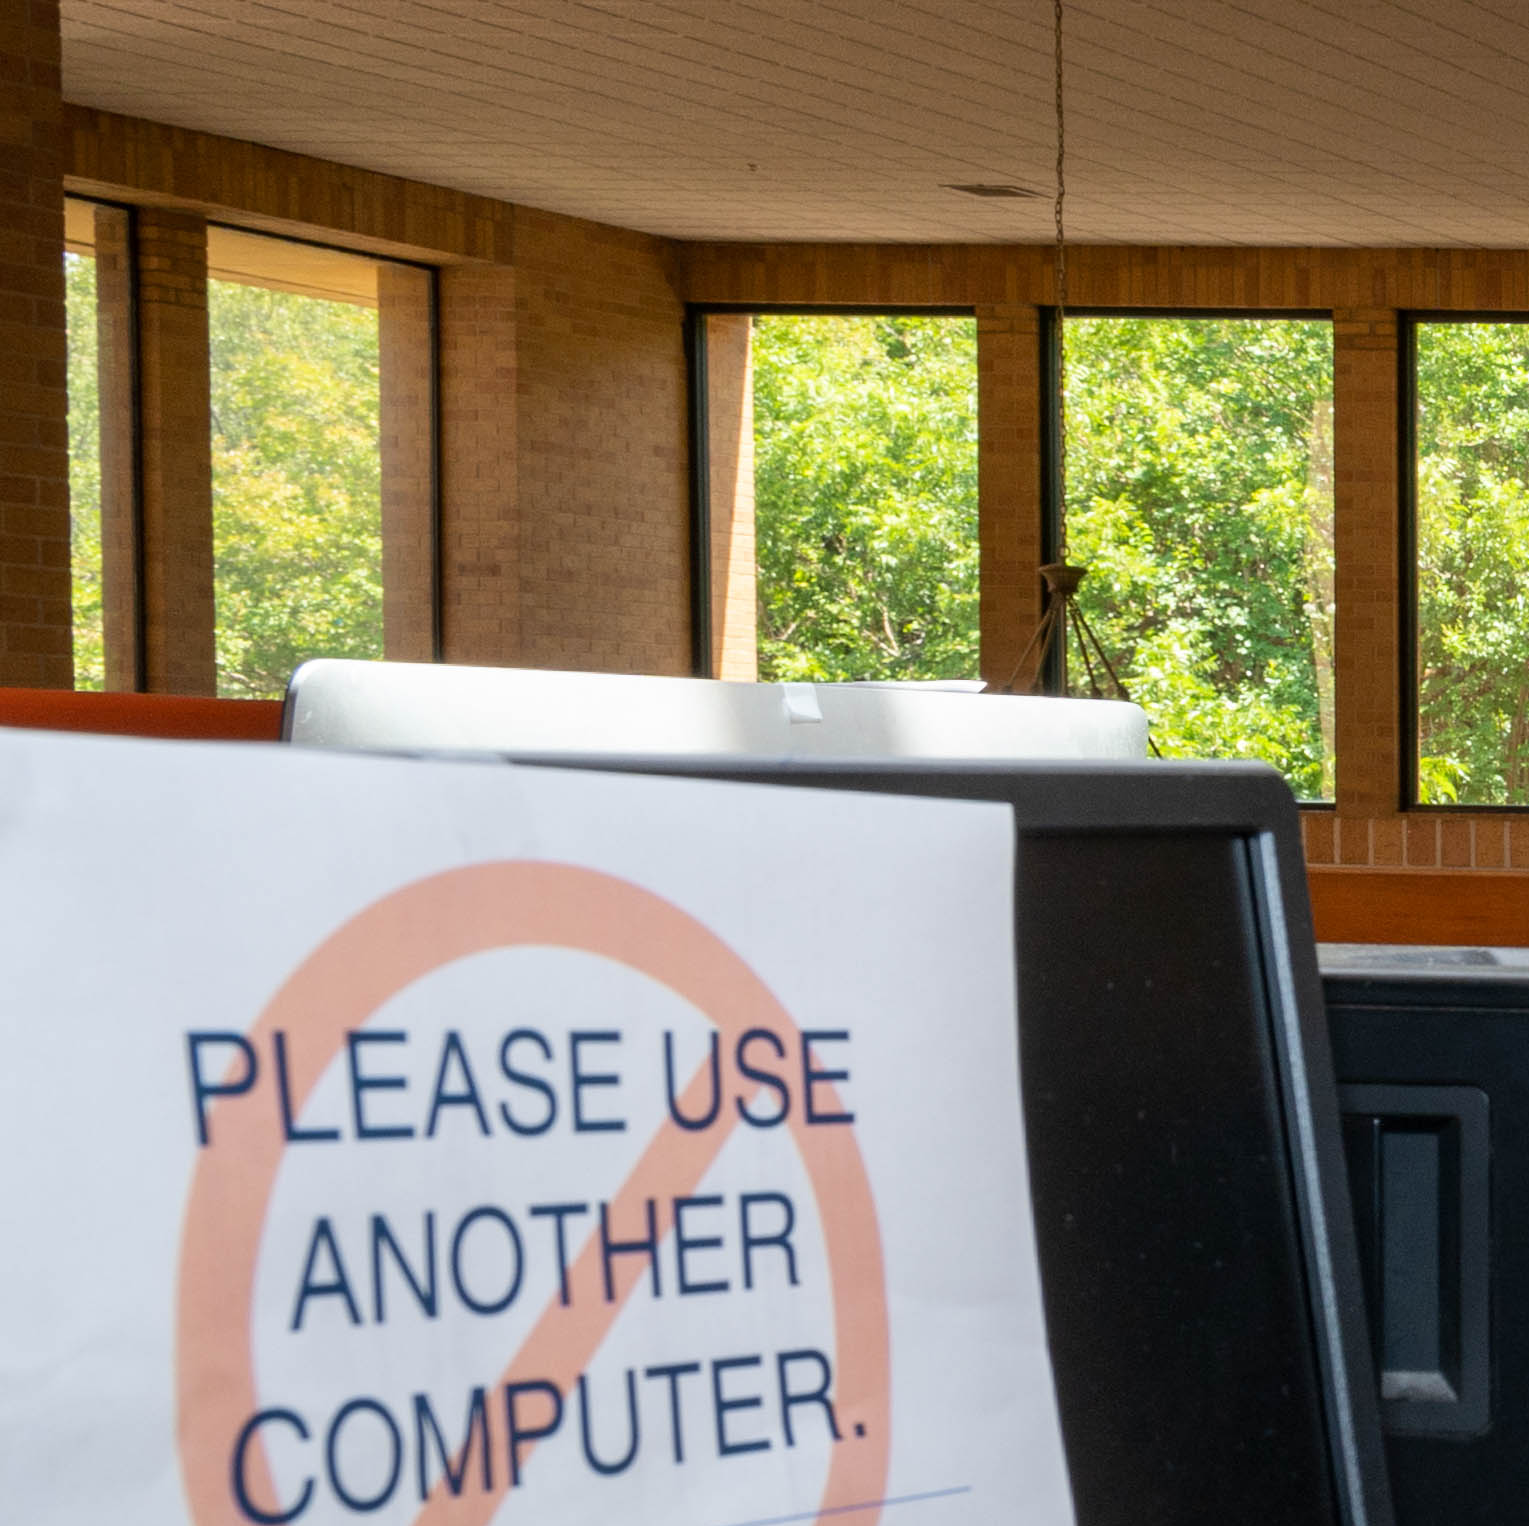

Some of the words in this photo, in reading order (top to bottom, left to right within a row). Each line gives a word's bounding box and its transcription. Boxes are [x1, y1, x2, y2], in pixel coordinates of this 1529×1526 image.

[186, 1028, 627, 1147] PLEASE
[663, 1029, 856, 1132] USE
[290, 1191, 800, 1332] ANOTHER
